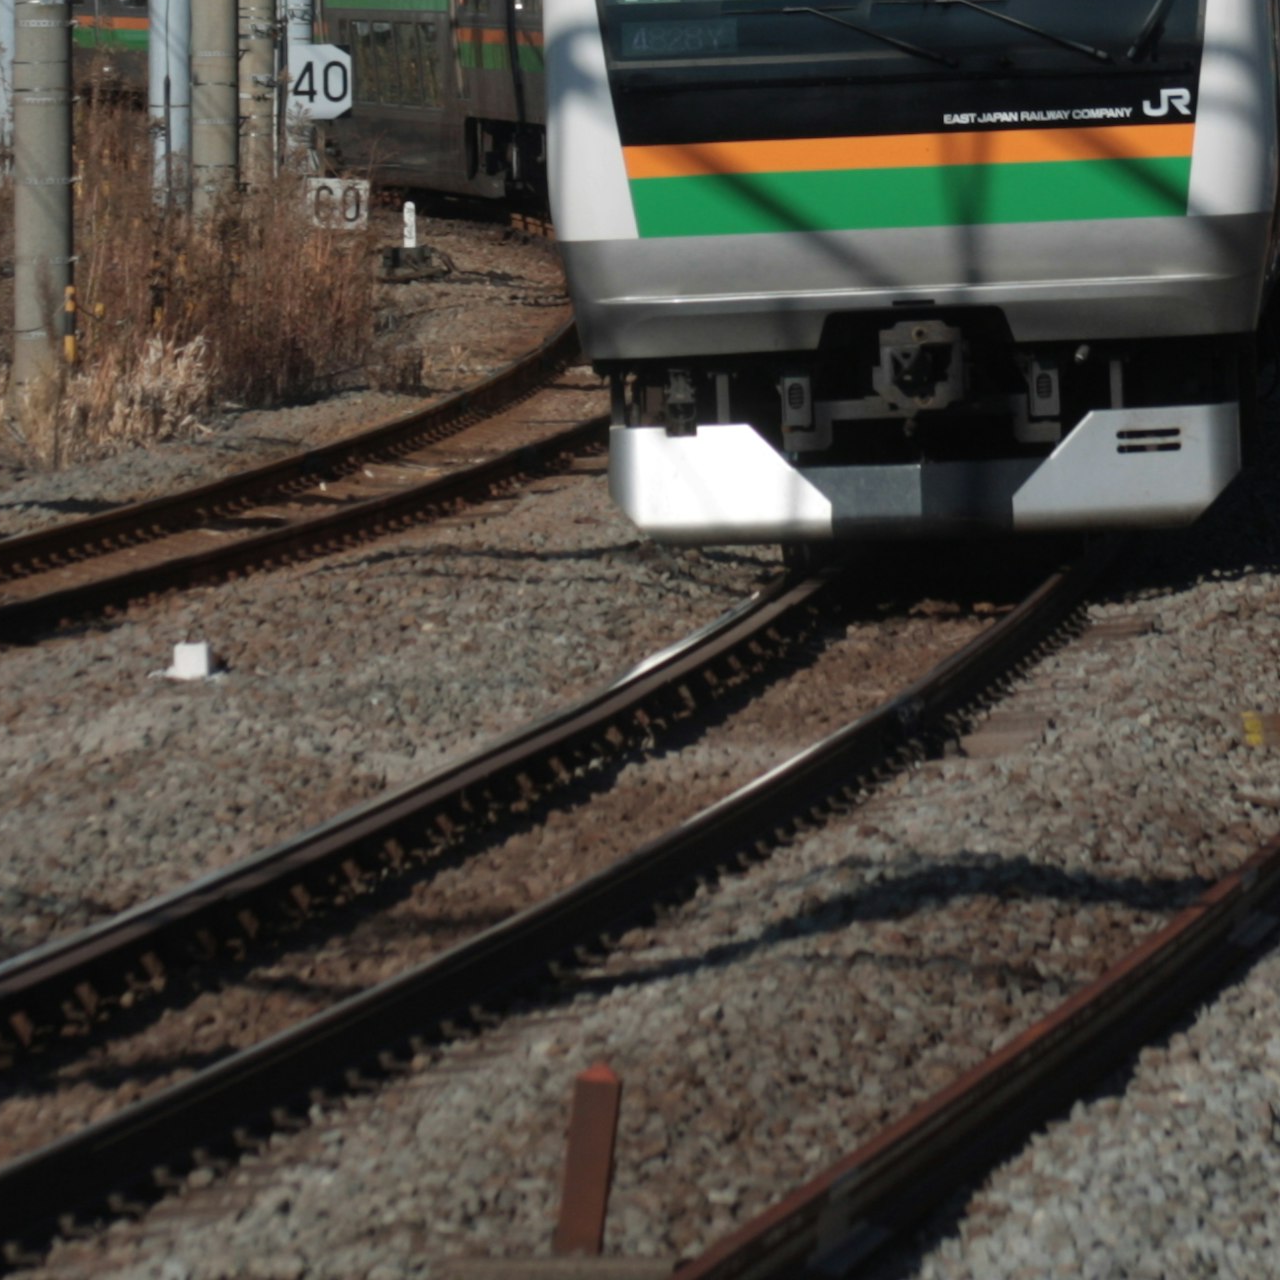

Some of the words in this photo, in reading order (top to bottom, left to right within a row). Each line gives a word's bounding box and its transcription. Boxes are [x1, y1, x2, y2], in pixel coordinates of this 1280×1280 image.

[293, 61, 348, 103] 40
[943, 113, 977, 125] EAST
[977, 111, 1019, 123] JAPAN
[1020, 109, 1070, 122] RAILWAY
[1072, 107, 1132, 120] COMPANY
[1142, 88, 1191, 117] JR
